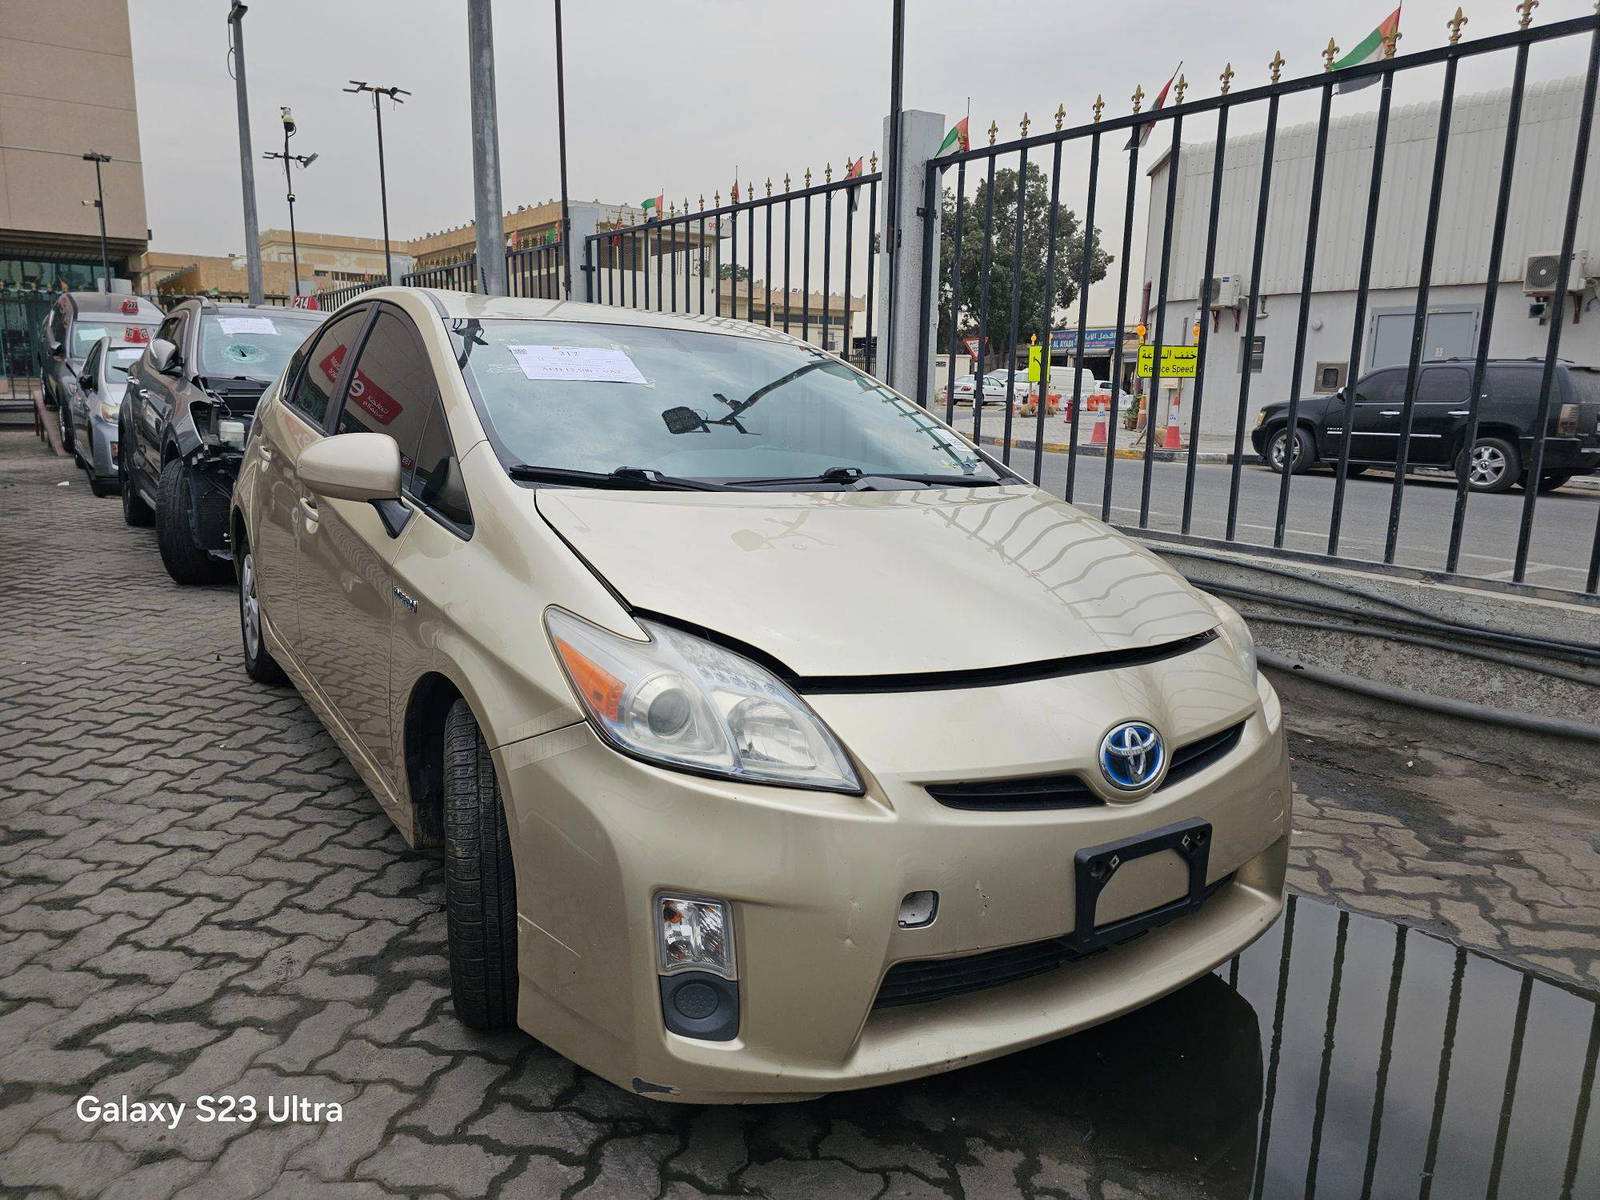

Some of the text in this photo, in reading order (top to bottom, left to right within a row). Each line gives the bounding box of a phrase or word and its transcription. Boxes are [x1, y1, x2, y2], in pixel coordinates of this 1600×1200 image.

[294, 296, 308, 309] 214
[1142, 349, 1172, 360] السعة
[1143, 364, 1194, 375] Rece Speed
